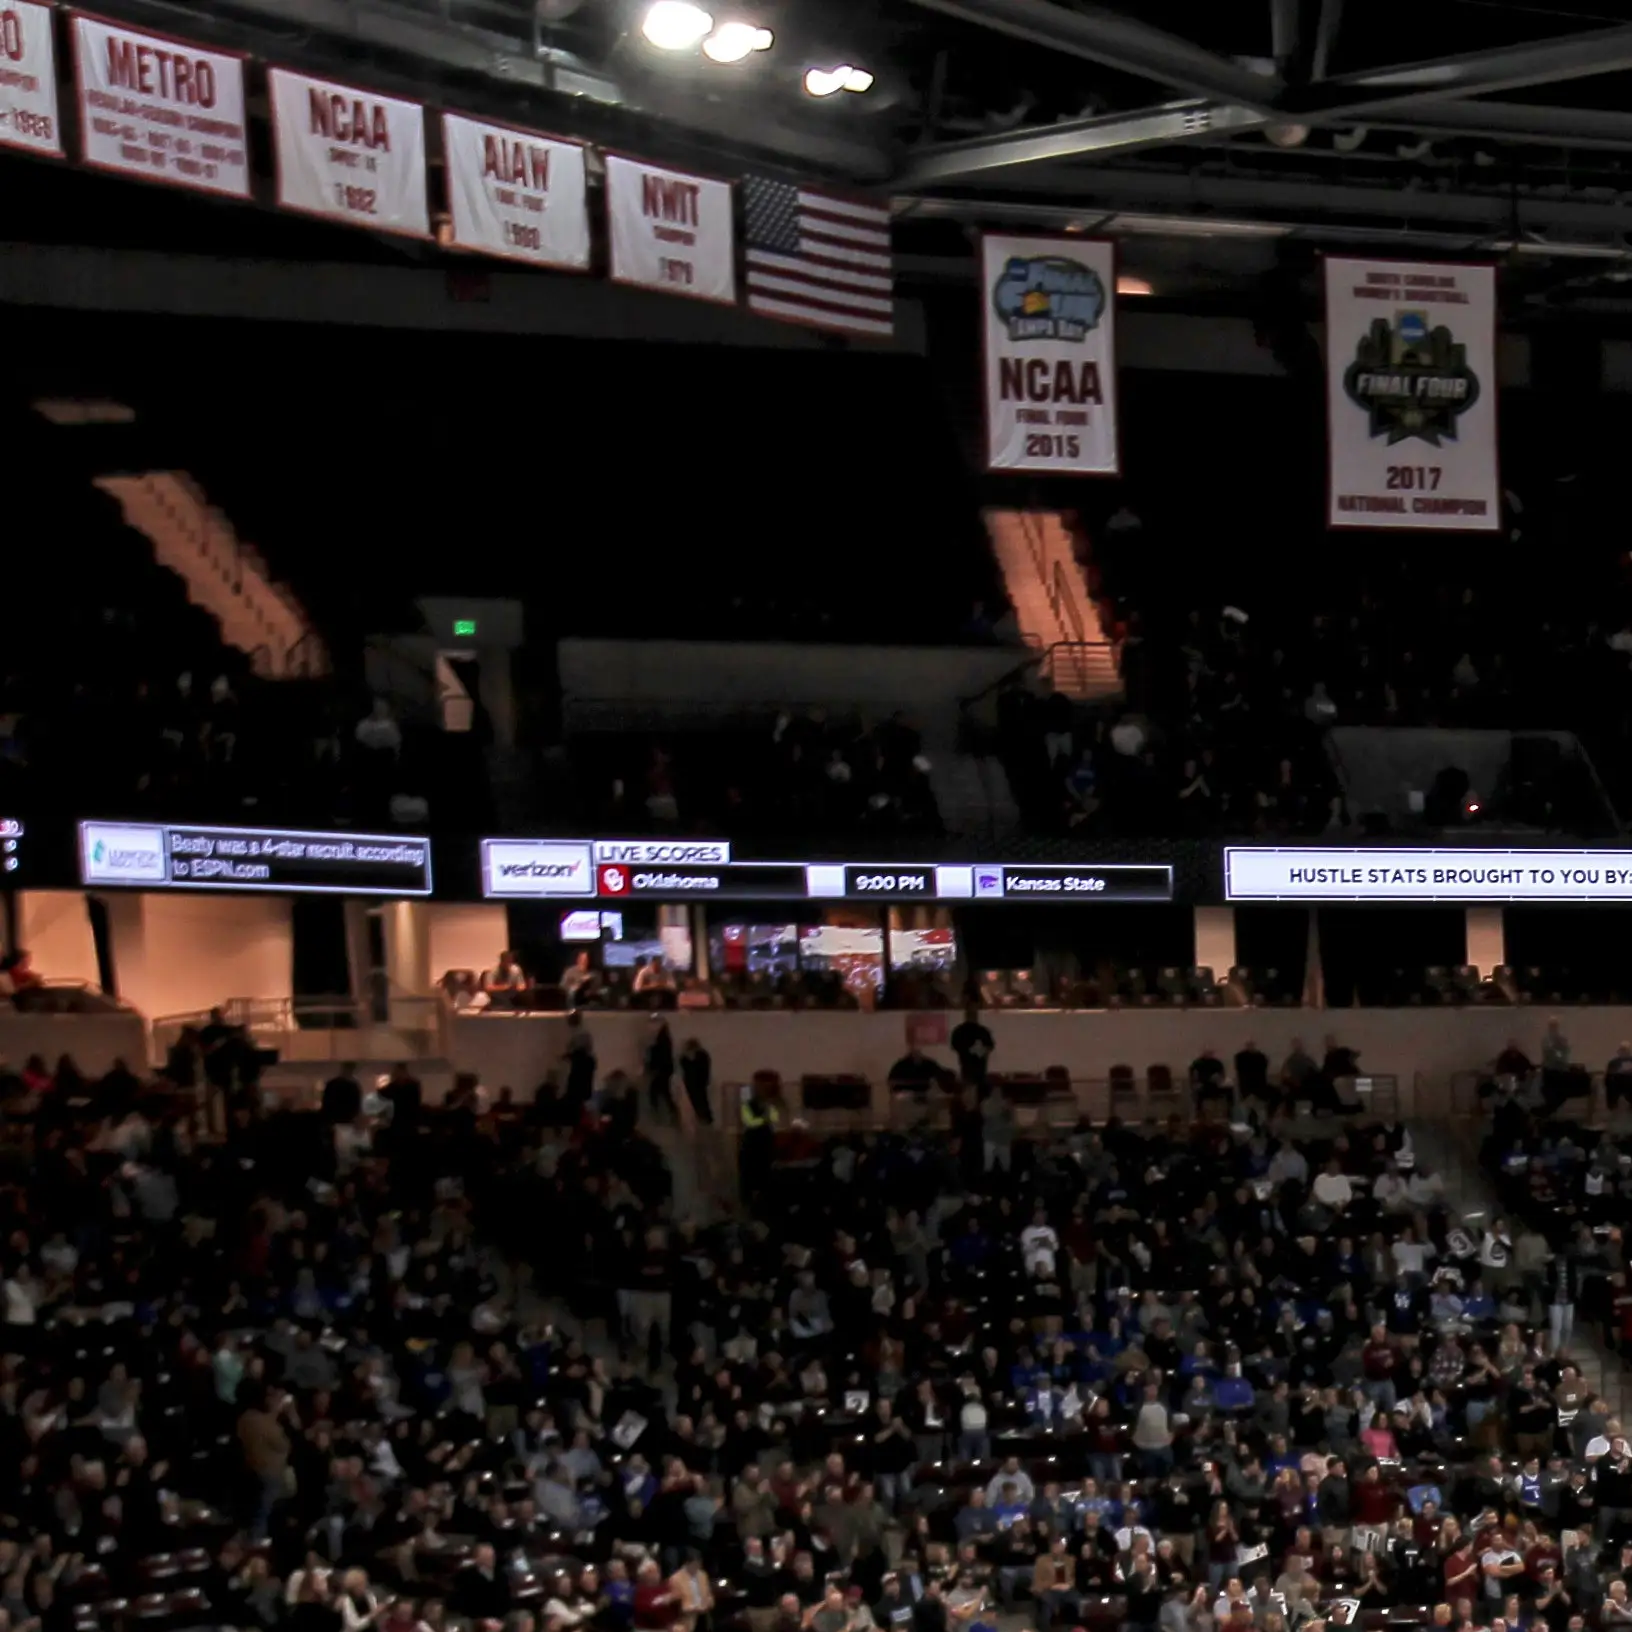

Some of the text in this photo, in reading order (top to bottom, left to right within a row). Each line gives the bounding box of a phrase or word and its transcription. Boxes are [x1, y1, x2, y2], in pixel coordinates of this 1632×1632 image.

[107, 36, 217, 108] METRO
[309, 88, 390, 152] NCAA
[485, 135, 549, 191] AIAW
[999, 357, 1103, 405] NCAA
[1357, 374, 1468, 398] FINAL FOUR
[1026, 434, 1080, 458] 2015
[1387, 466, 1442, 490] 2017
[600, 846, 723, 862] LIVE SCORES
[499, 861, 571, 877] verizon
[632, 873, 719, 889] Oklahoma
[1290, 869, 1363, 883] HUSTLE
[1368, 869, 1427, 884] STATS
[1433, 869, 1524, 884] BROUGHT
[1529, 870, 1555, 884] TO
[1559, 870, 1600, 884] YOU
[856, 875, 1105, 891] 9:00 PM Kansas State
